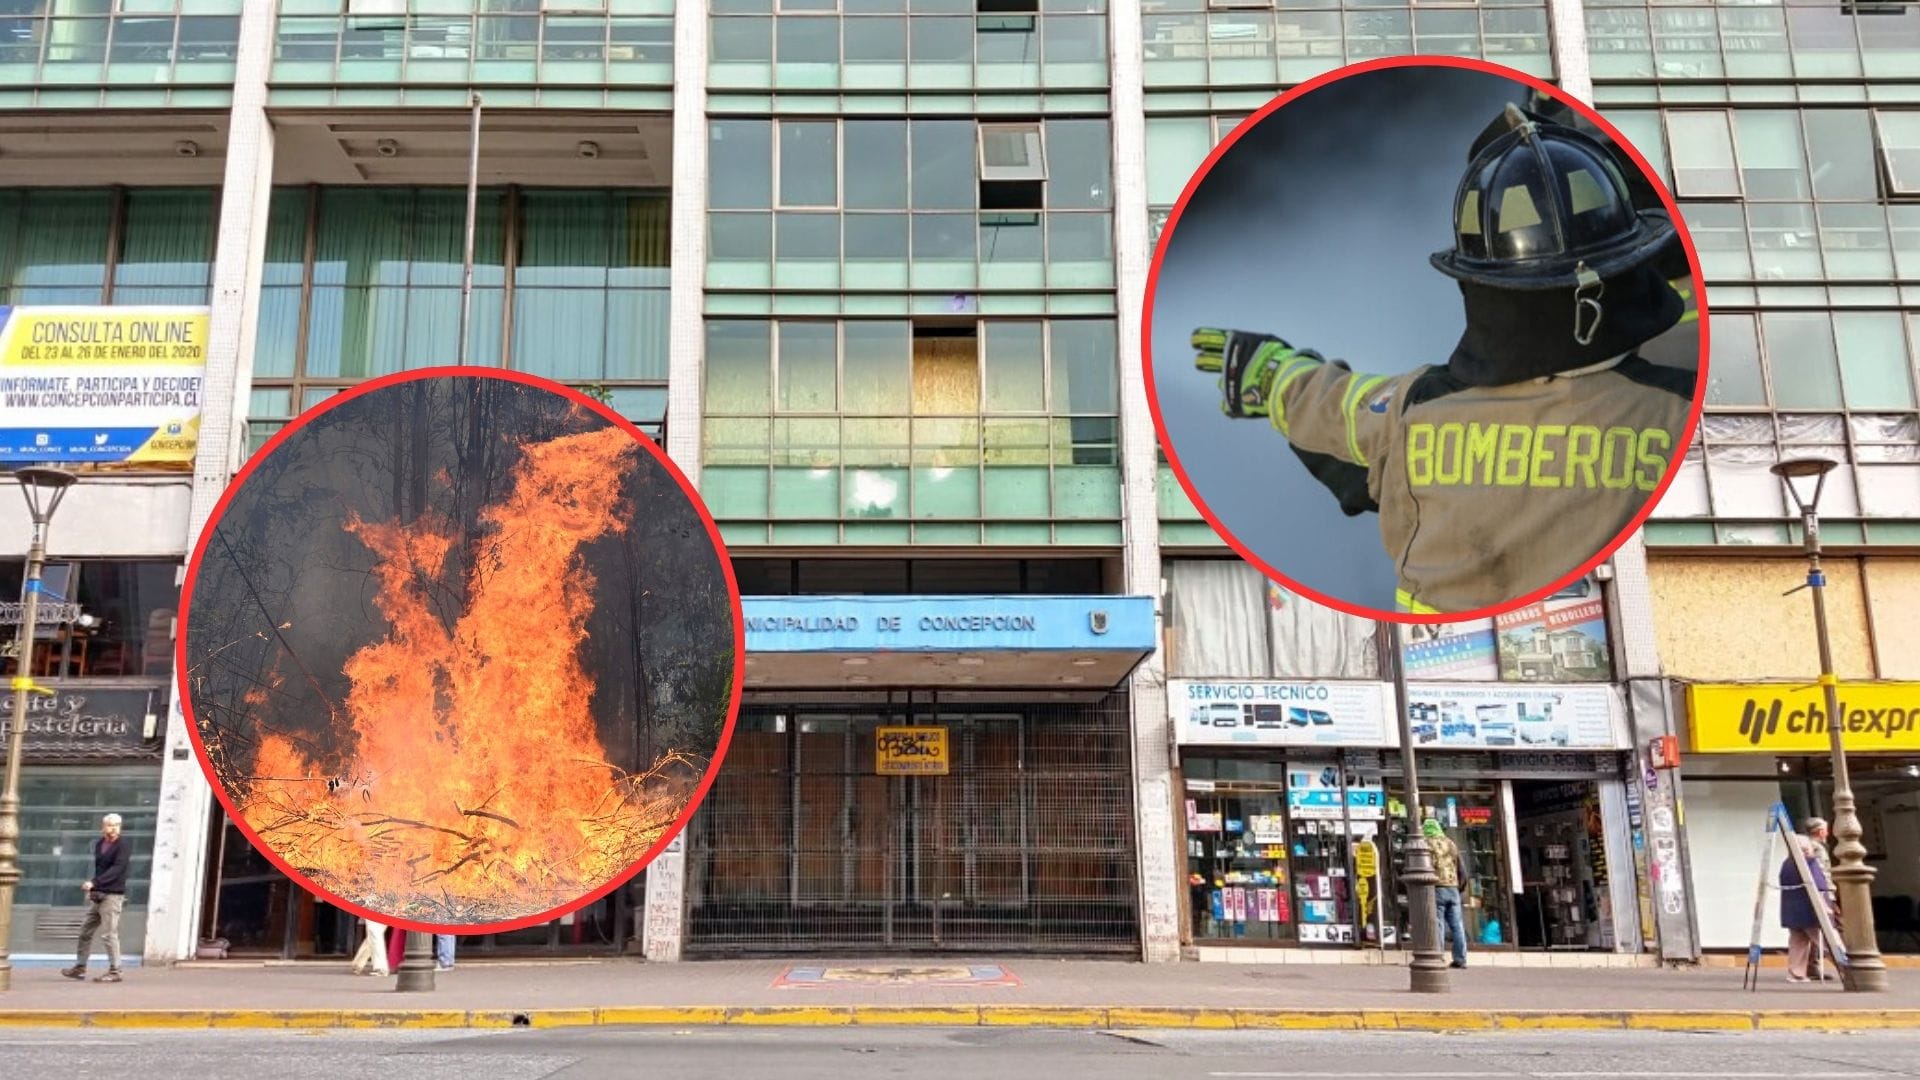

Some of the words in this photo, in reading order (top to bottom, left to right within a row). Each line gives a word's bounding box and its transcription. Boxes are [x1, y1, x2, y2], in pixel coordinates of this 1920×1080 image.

[32, 321, 122, 344] CONSULTA
[129, 321, 194, 343] ONLINE
[21, 347, 41, 360] DEL
[44, 347, 58, 360] 23
[60, 347, 74, 359] AL
[77, 347, 91, 359] 26
[94, 347, 107, 359] DE
[111, 346, 146, 359] ENERO
[149, 346, 167, 359] DEL
[171, 346, 201, 359] 2020
[76, 377, 138, 391] PARTICIPA
[142, 377, 150, 391] Y
[5, 391, 199, 408] WWW.CONCEPCIONPARTICIPA.CL
[1406, 422, 1672, 491] BOMBEROS
[876, 616, 901, 632] DE
[1187, 685, 1255, 700] SERVICIO
[1262, 685, 1329, 700] TECNICO
[1786, 702, 1920, 739] chlexpr
